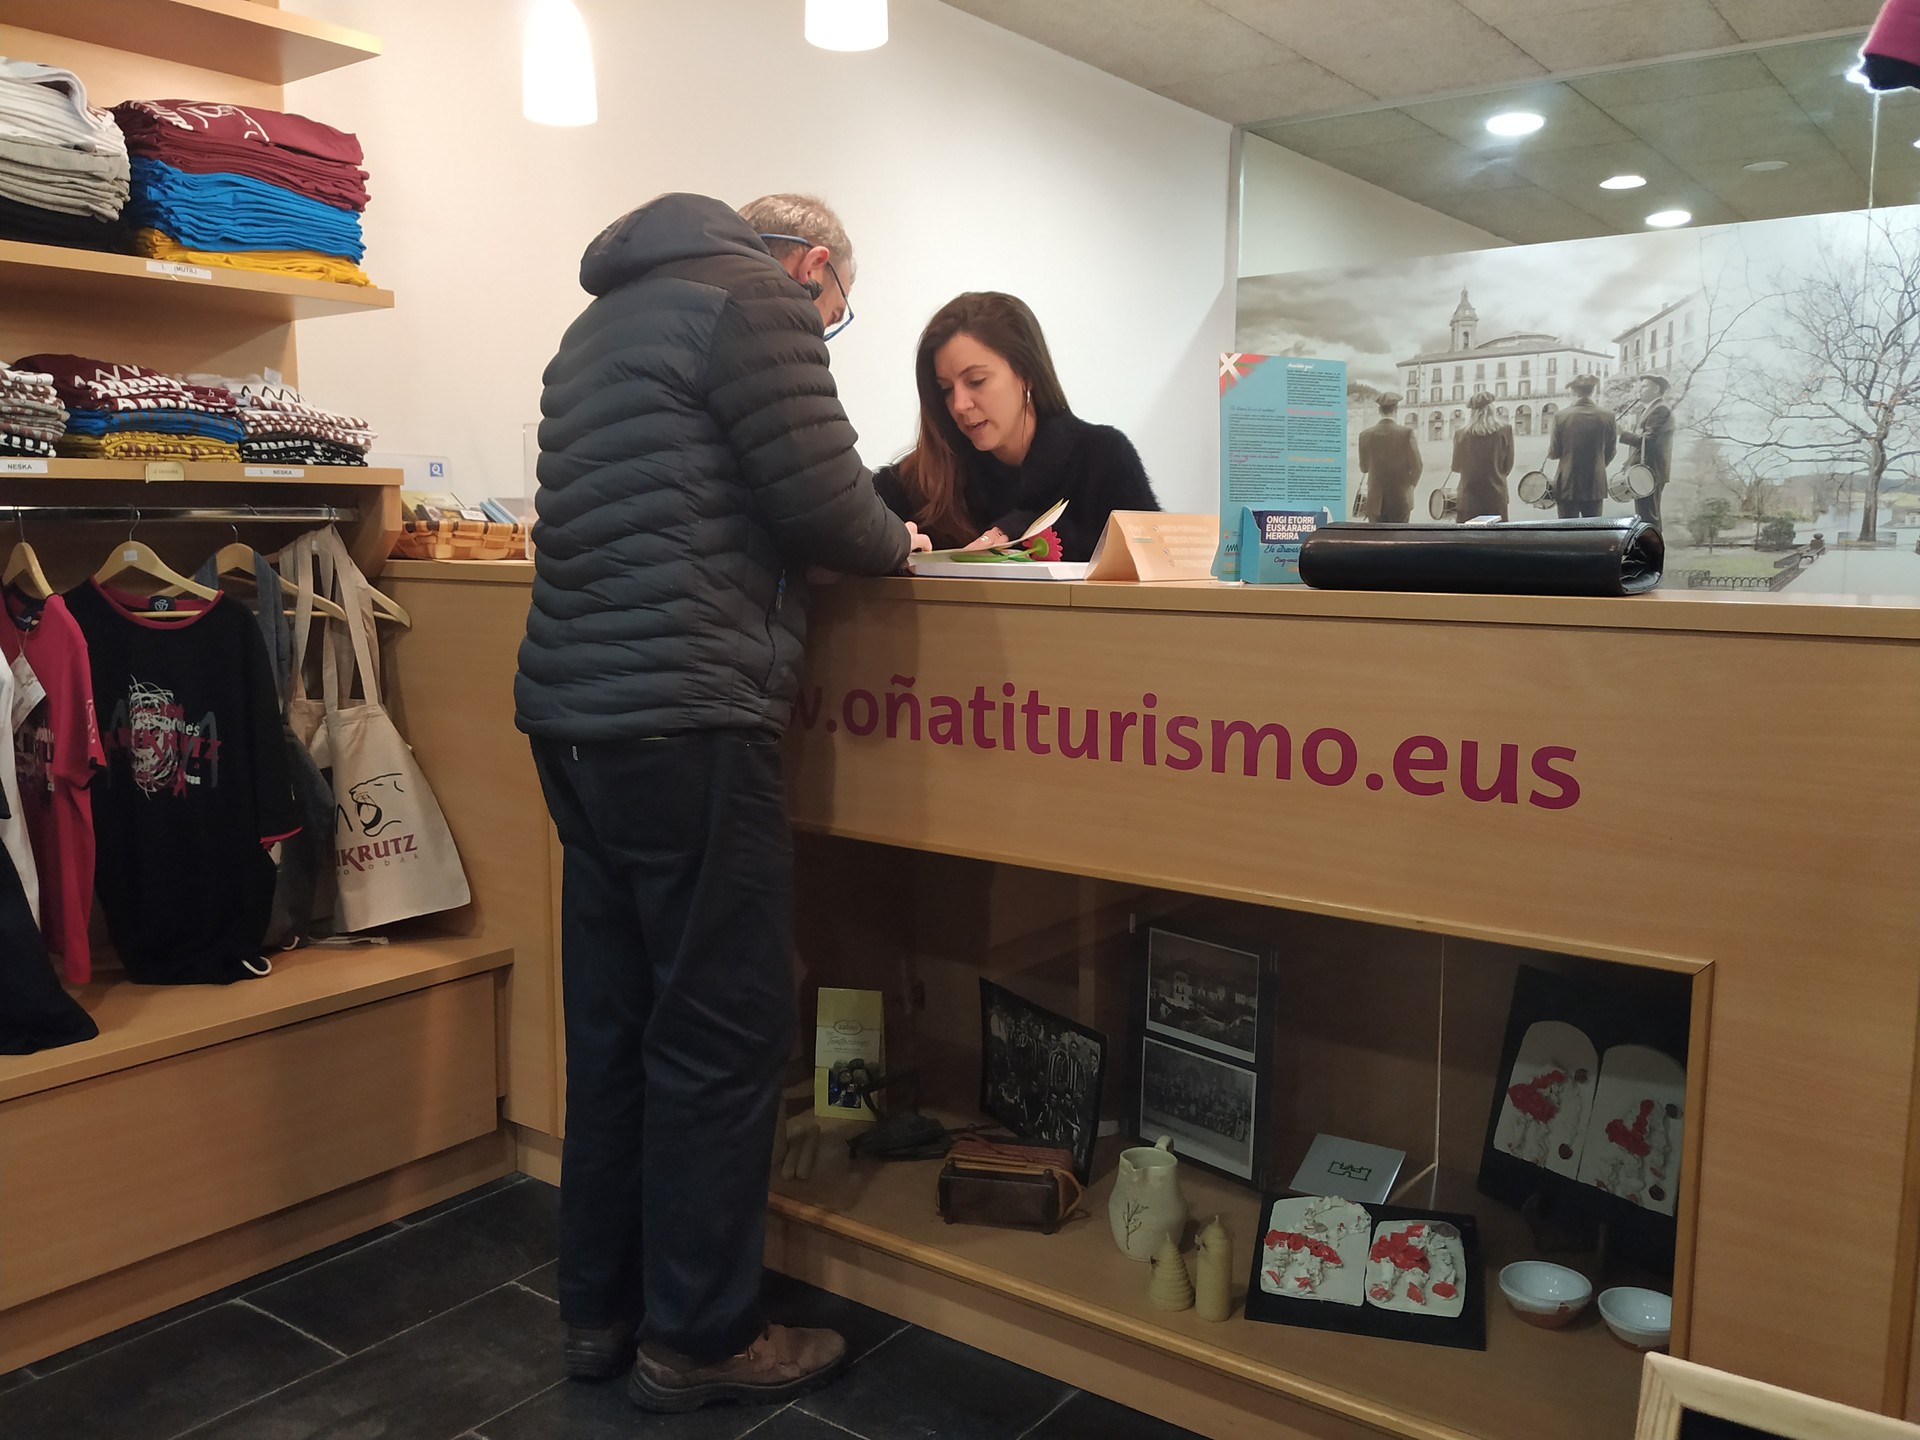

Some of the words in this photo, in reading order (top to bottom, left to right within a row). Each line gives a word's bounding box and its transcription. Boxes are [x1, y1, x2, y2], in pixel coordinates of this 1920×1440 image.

[1266, 515, 1287, 524] ONGI
[1288, 516, 1315, 524] ETORRI
[1266, 524, 1317, 532] EUSKARAREN
[1265, 532, 1299, 540] HERRIRA
